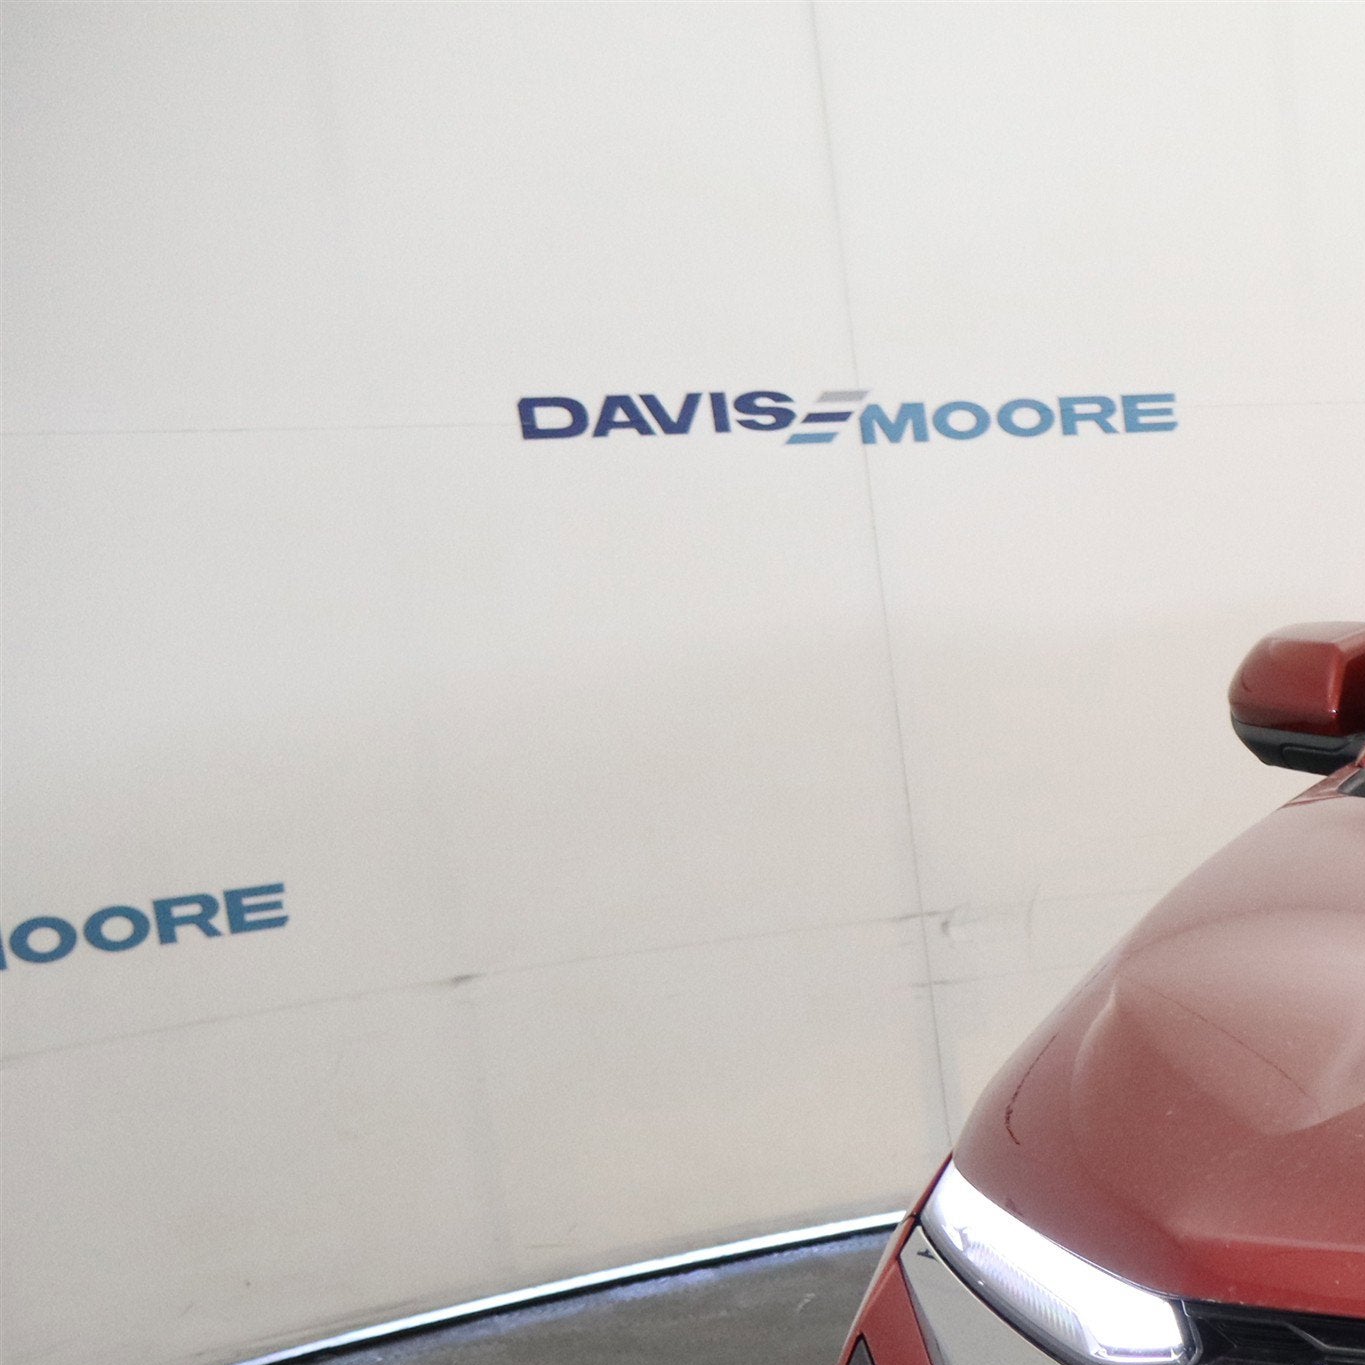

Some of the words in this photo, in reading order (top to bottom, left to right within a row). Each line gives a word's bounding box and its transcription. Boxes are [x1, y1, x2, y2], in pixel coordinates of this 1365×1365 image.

[517, 390, 796, 440] DAVIS
[859, 393, 1178, 444] MOORE
[0, 882, 289, 970] OORE
